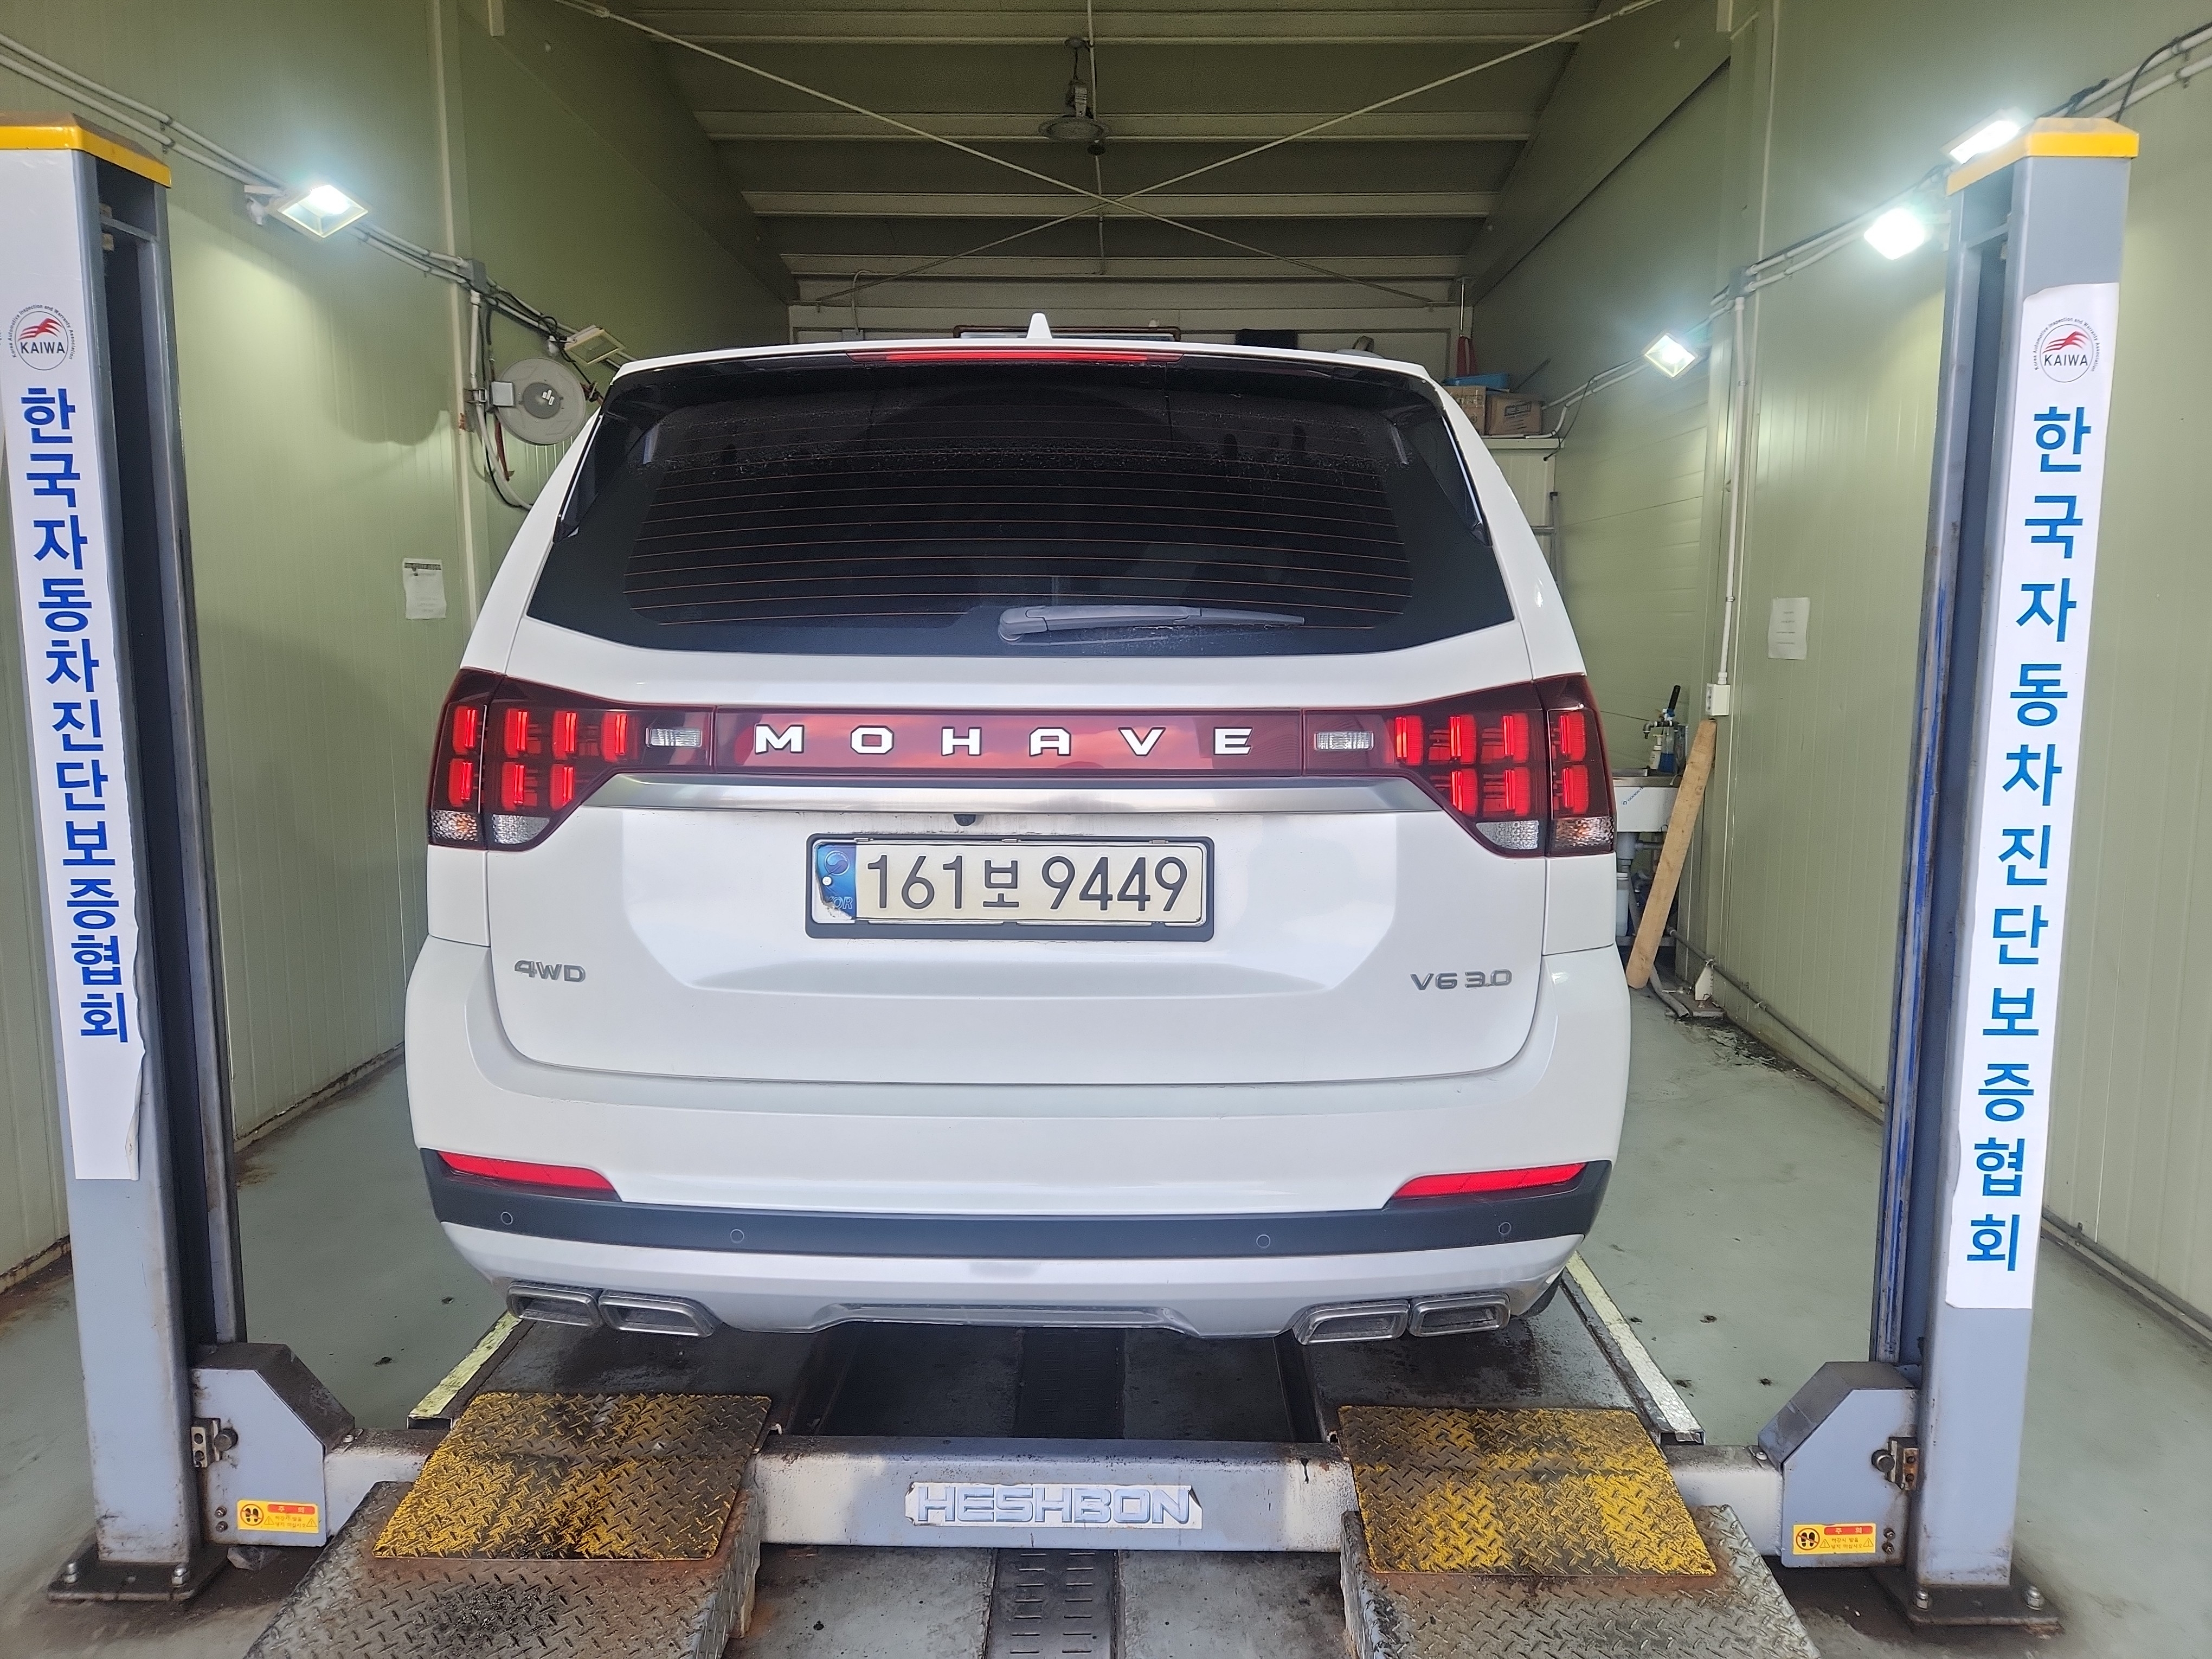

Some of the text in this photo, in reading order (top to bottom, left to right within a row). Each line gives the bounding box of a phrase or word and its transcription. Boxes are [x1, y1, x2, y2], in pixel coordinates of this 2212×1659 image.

[8, 314, 21, 342] Automotive
[18, 304, 43, 315] Inspection
[54, 308, 71, 329] Warranty
[20, 342, 66, 354] KAIWA
[2043, 354, 2088, 366] KAIWA
[20, 387, 128, 1043] 한국자동차진단보증협회
[754, 724, 1253, 757] MOHAVE
[1966, 406, 2092, 1272] 한국자동차진단보증협회
[867, 854, 1188, 911] 161보 9449
[514, 960, 586, 983] 4WD
[1410, 973, 1458, 991] V6
[917, 1486, 1190, 1525] HESHBON
